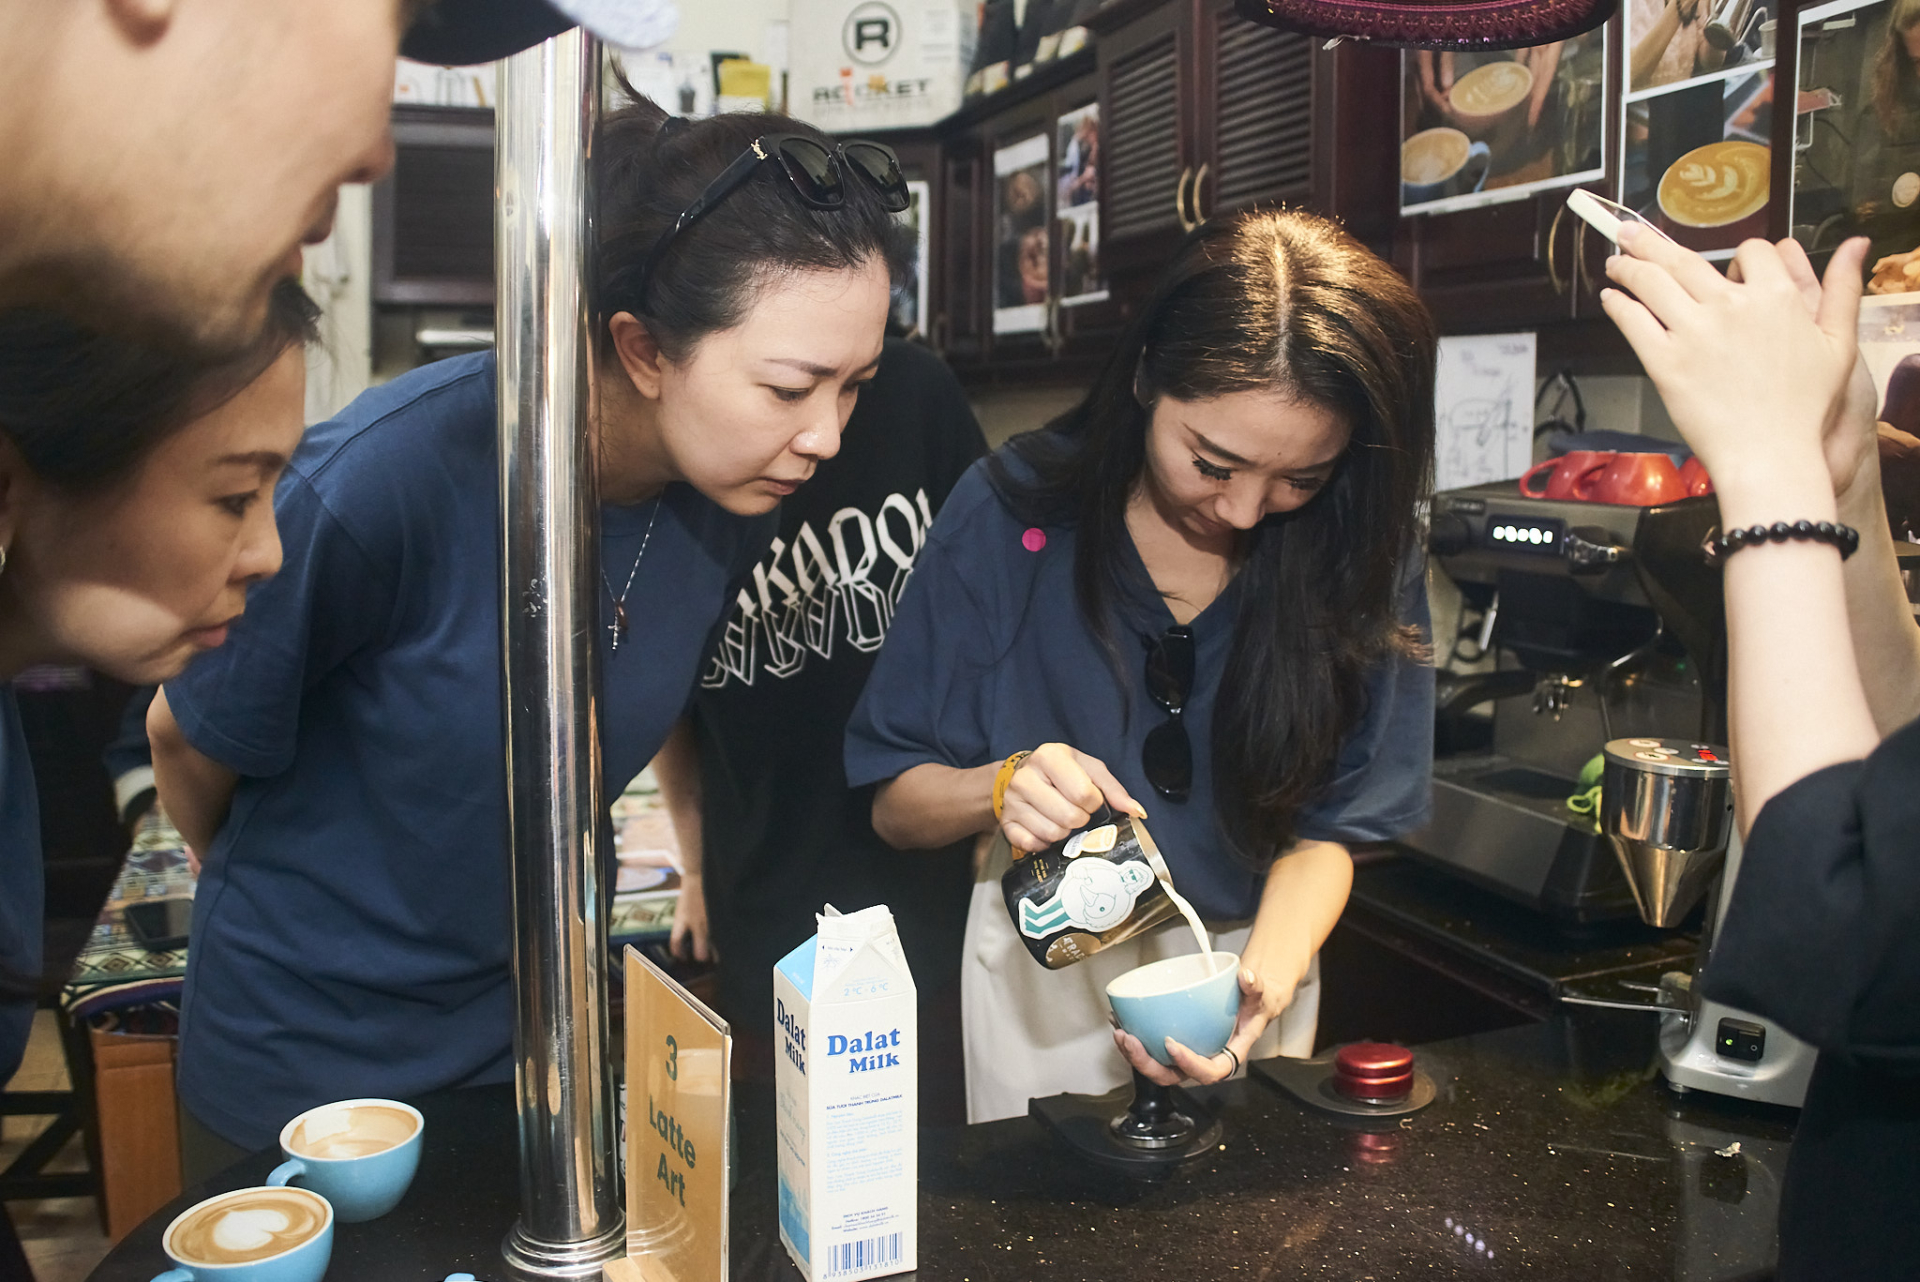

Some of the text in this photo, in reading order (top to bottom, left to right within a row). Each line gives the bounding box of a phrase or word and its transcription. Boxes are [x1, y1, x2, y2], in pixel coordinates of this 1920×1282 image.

[856, 19, 889, 50] R
[777, 998, 806, 1051] Dalat
[827, 1028, 900, 1056] Dalat
[666, 1034, 678, 1081] 3
[785, 1036, 806, 1076] Milk
[849, 1053, 900, 1074] Milk
[649, 1093, 696, 1170] Latte
[656, 1152, 686, 1208] Art
